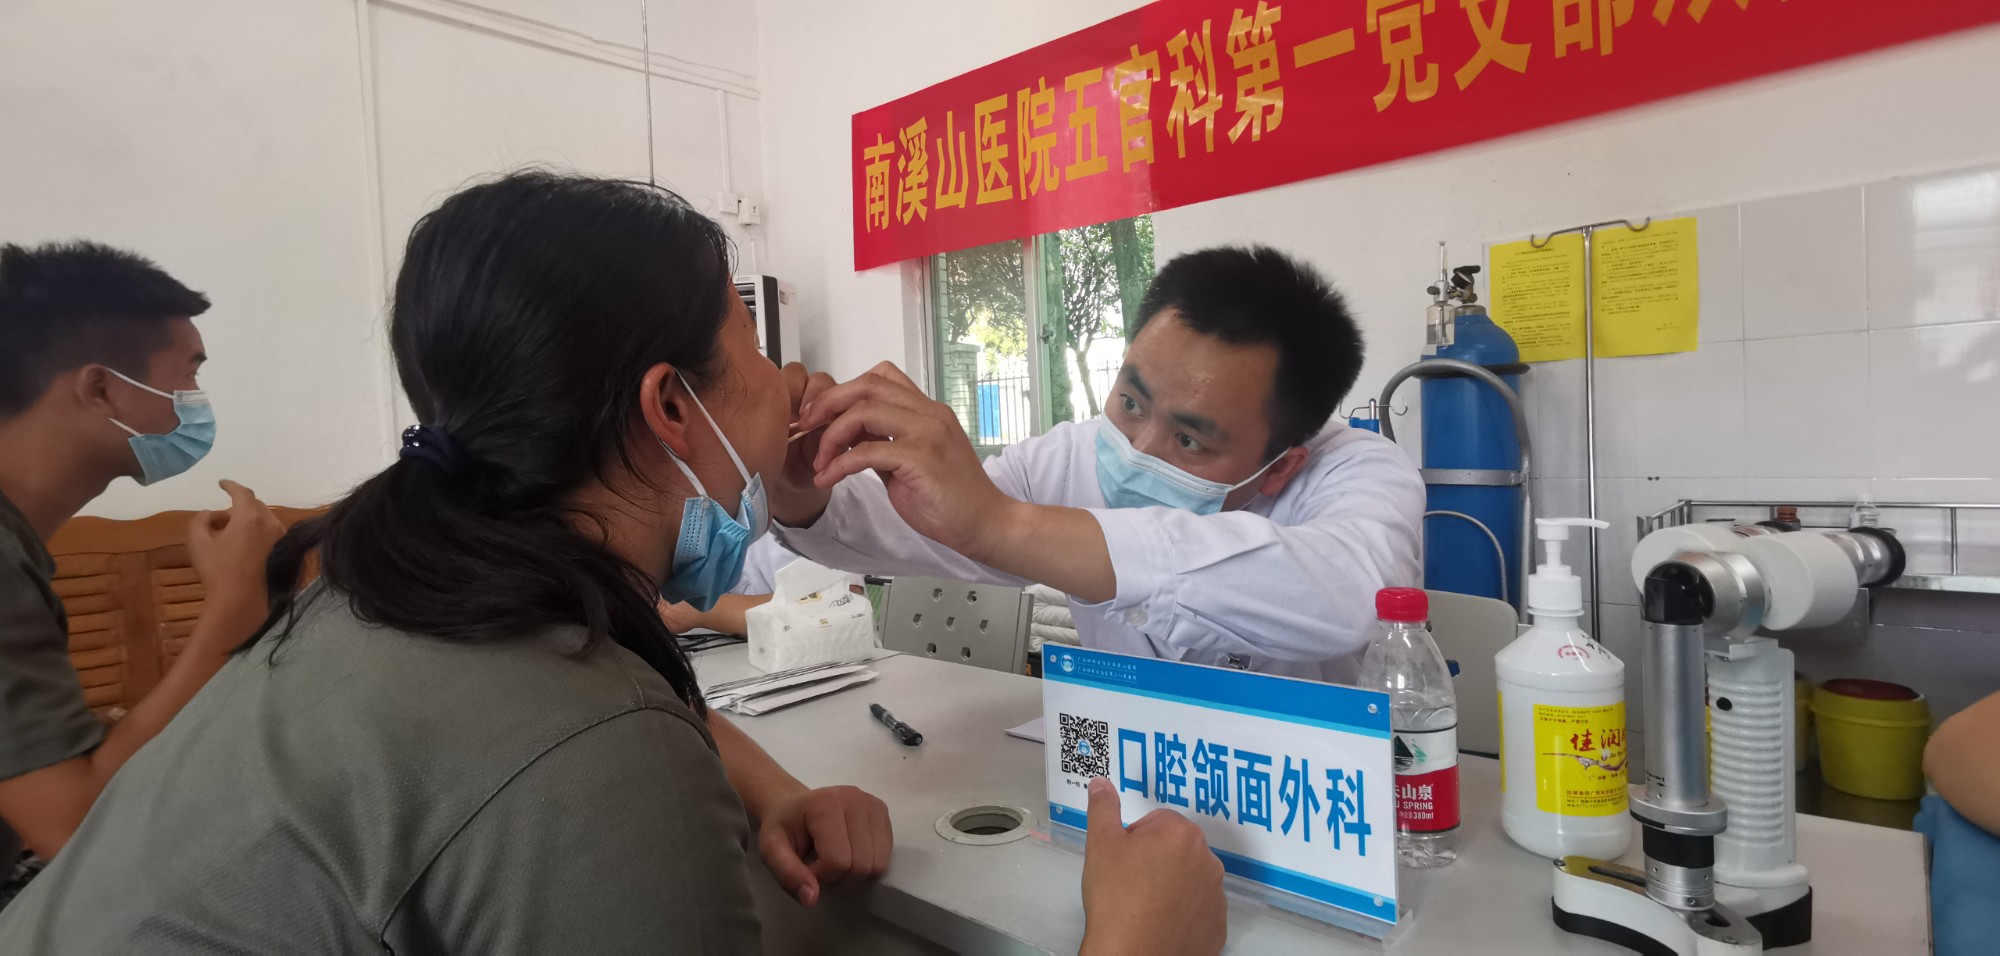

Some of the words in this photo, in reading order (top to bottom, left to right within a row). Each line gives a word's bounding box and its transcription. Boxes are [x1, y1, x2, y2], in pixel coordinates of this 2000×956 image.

[863, 0, 1752, 234] 南溪山医院五官科第一党支
[1570, 728, 1626, 752] 佳润
[1117, 727, 1372, 857] 口腔颌面外科
[1403, 801, 1434, 810] SPRING
